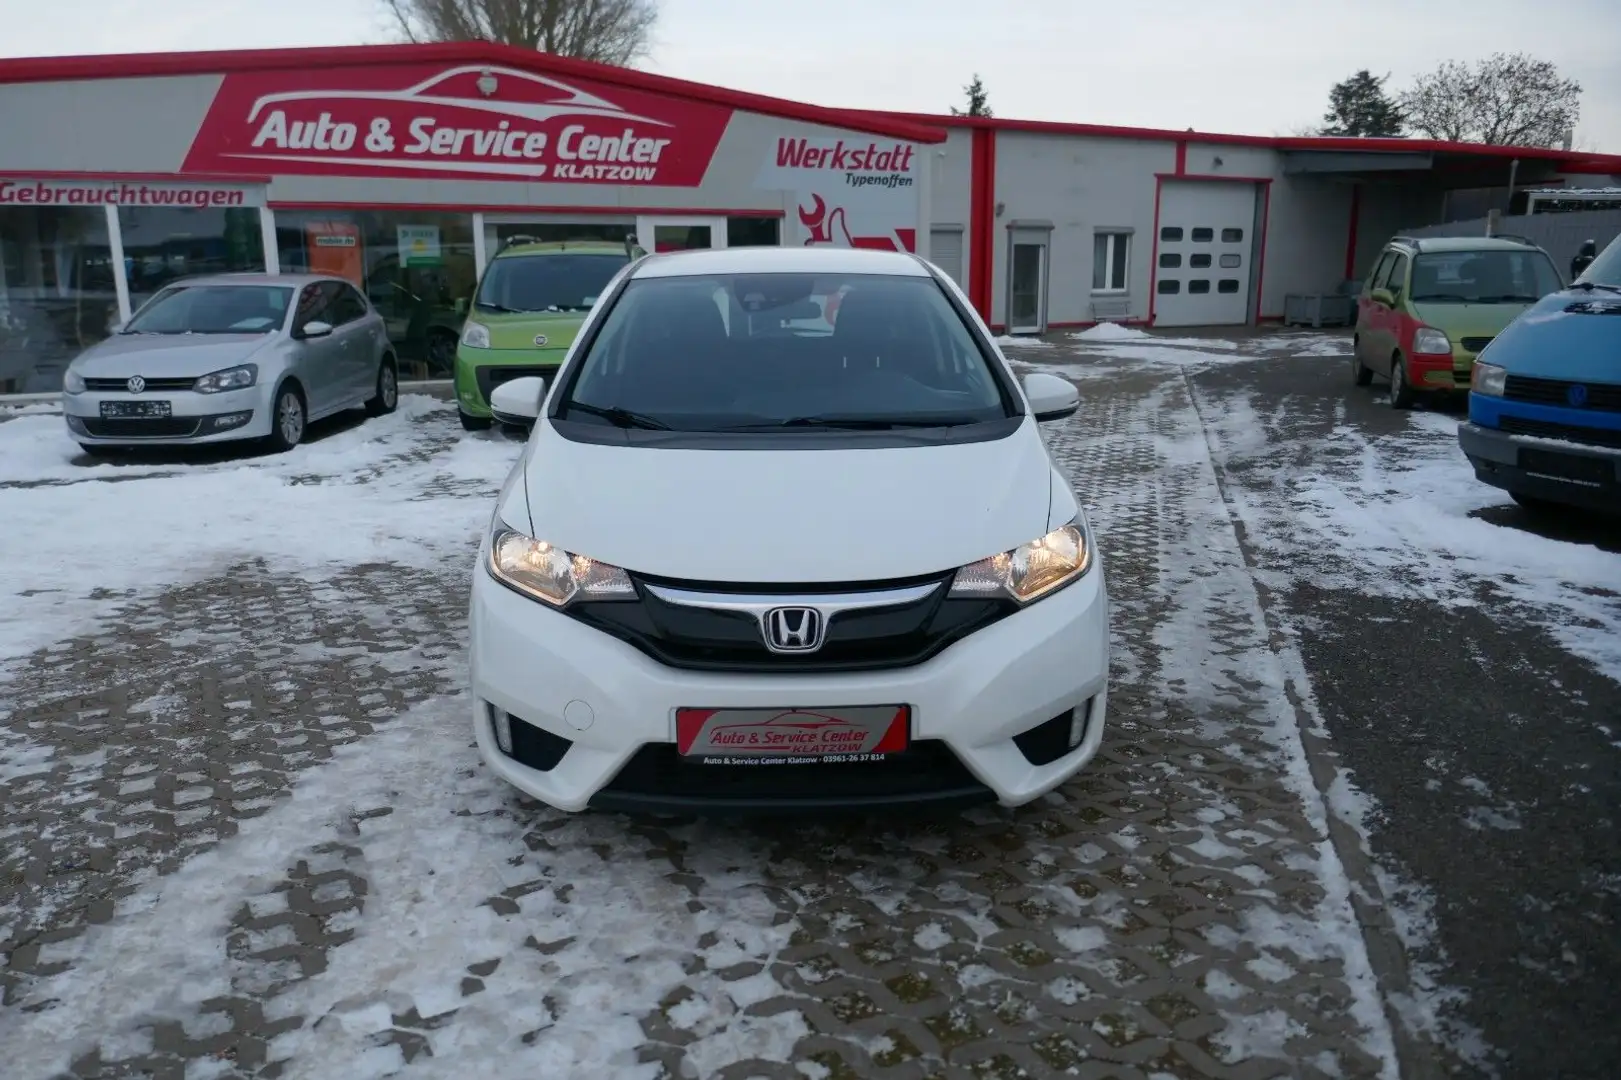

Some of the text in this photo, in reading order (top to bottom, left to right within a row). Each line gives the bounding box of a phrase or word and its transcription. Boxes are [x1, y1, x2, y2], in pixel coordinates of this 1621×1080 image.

[251, 110, 671, 164] Auto & Service Center
[776, 137, 914, 172] Werkstatt
[553, 163, 656, 181] KLATZOW
[845, 172, 913, 188] Typenoffen
[0, 182, 244, 209] Gebrauchtwagen
[710, 729, 869, 744] Auto & Service Center
[792, 743, 862, 753] KLATZOW
[704, 753, 885, 765] Auto & Service Center Klatzow 03961-26 37 814
